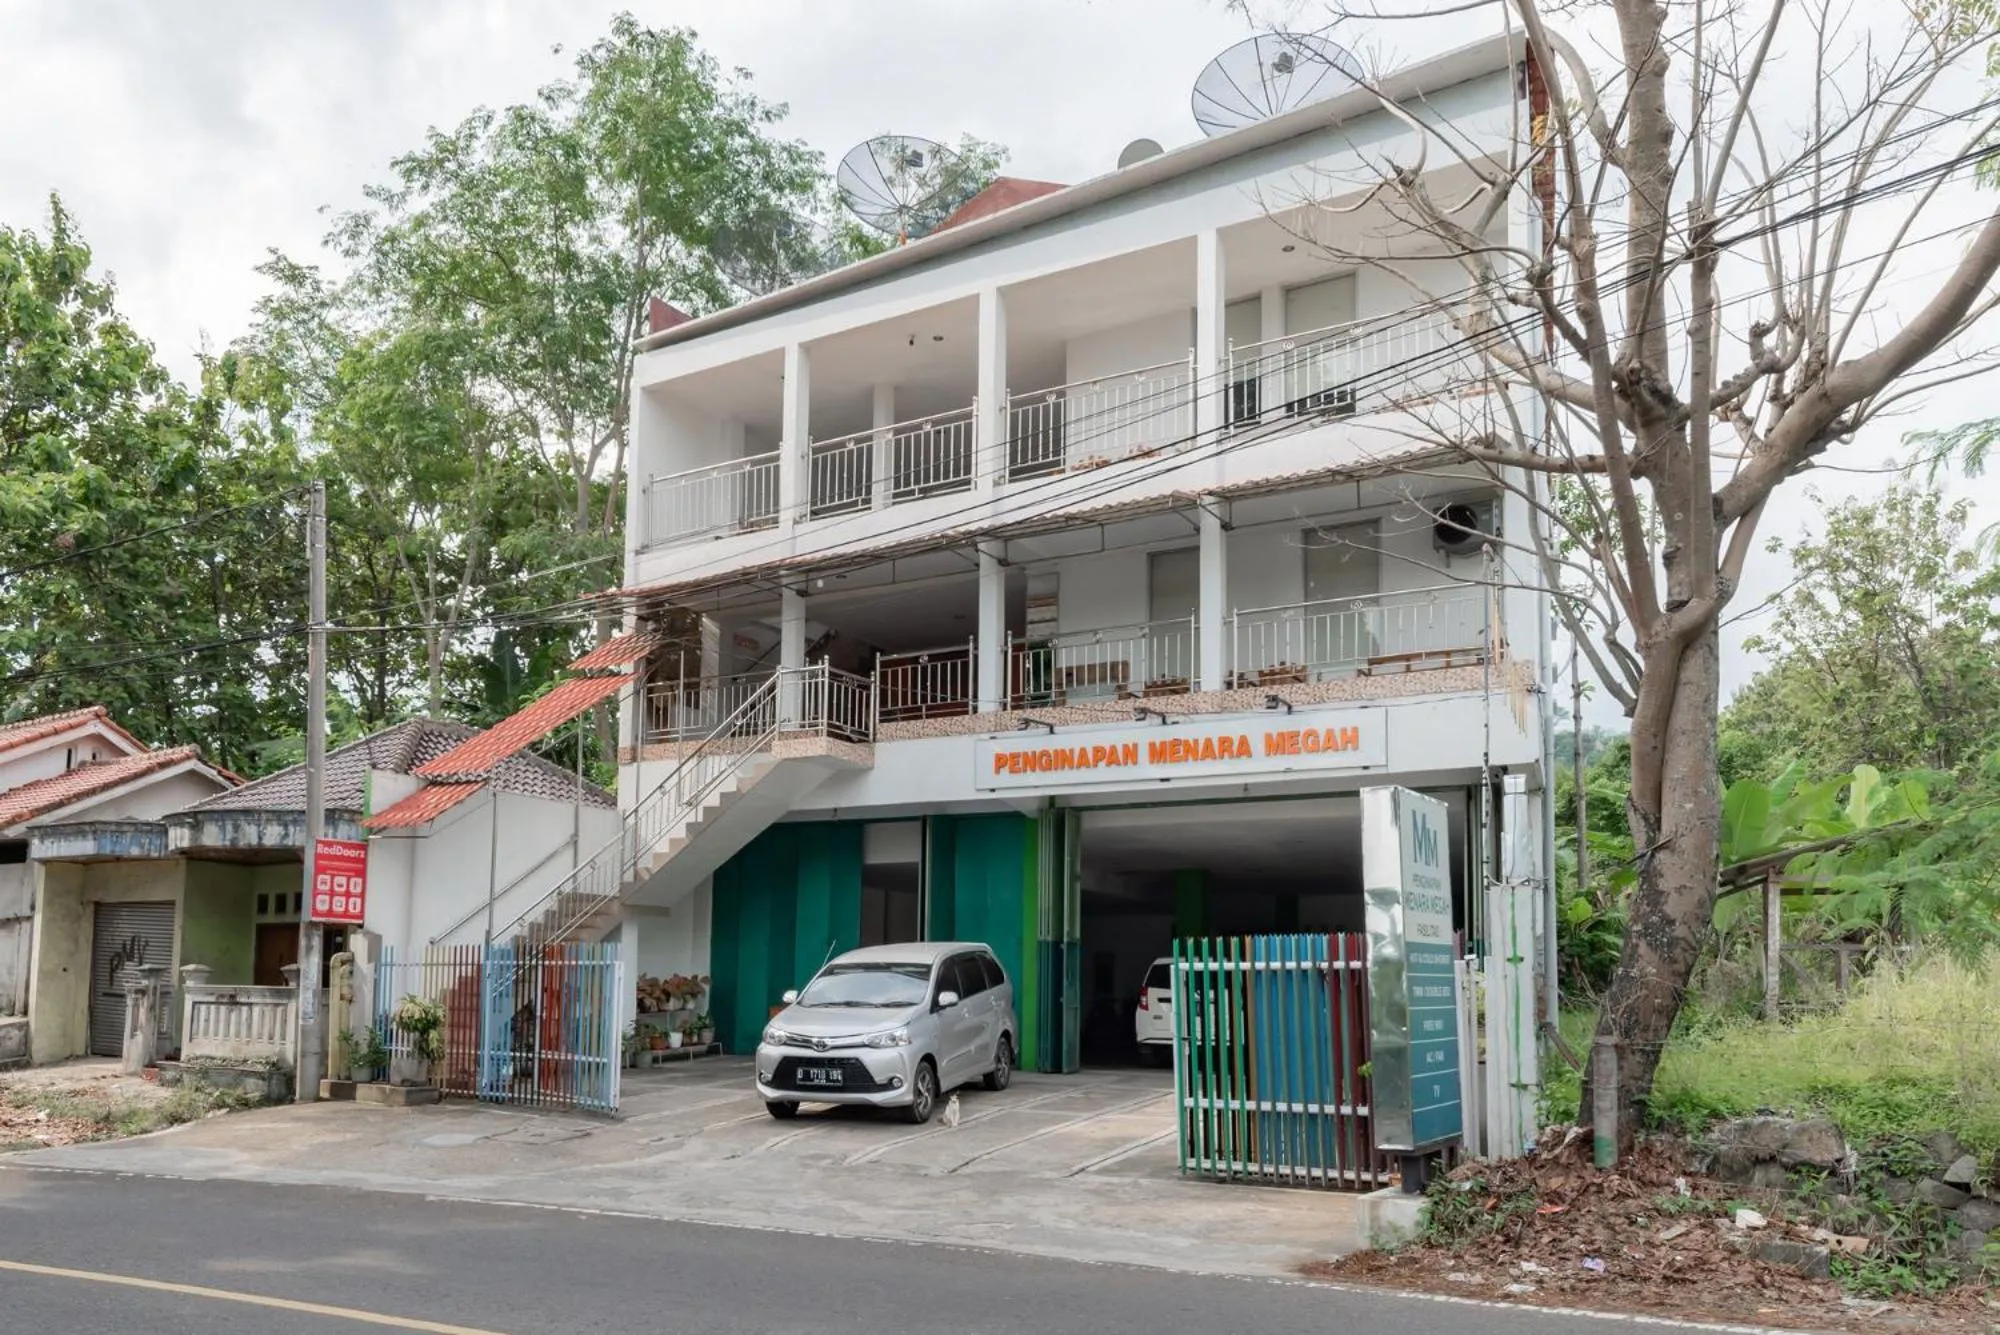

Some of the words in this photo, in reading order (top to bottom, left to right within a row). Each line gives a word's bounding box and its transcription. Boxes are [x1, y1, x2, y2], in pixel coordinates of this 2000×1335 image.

[994, 743, 1139, 775] PENGINAPAN
[1147, 734, 1253, 765] MENARA
[1264, 726, 1360, 758] MEGAH
[316, 843, 366, 859] RedDoorz
